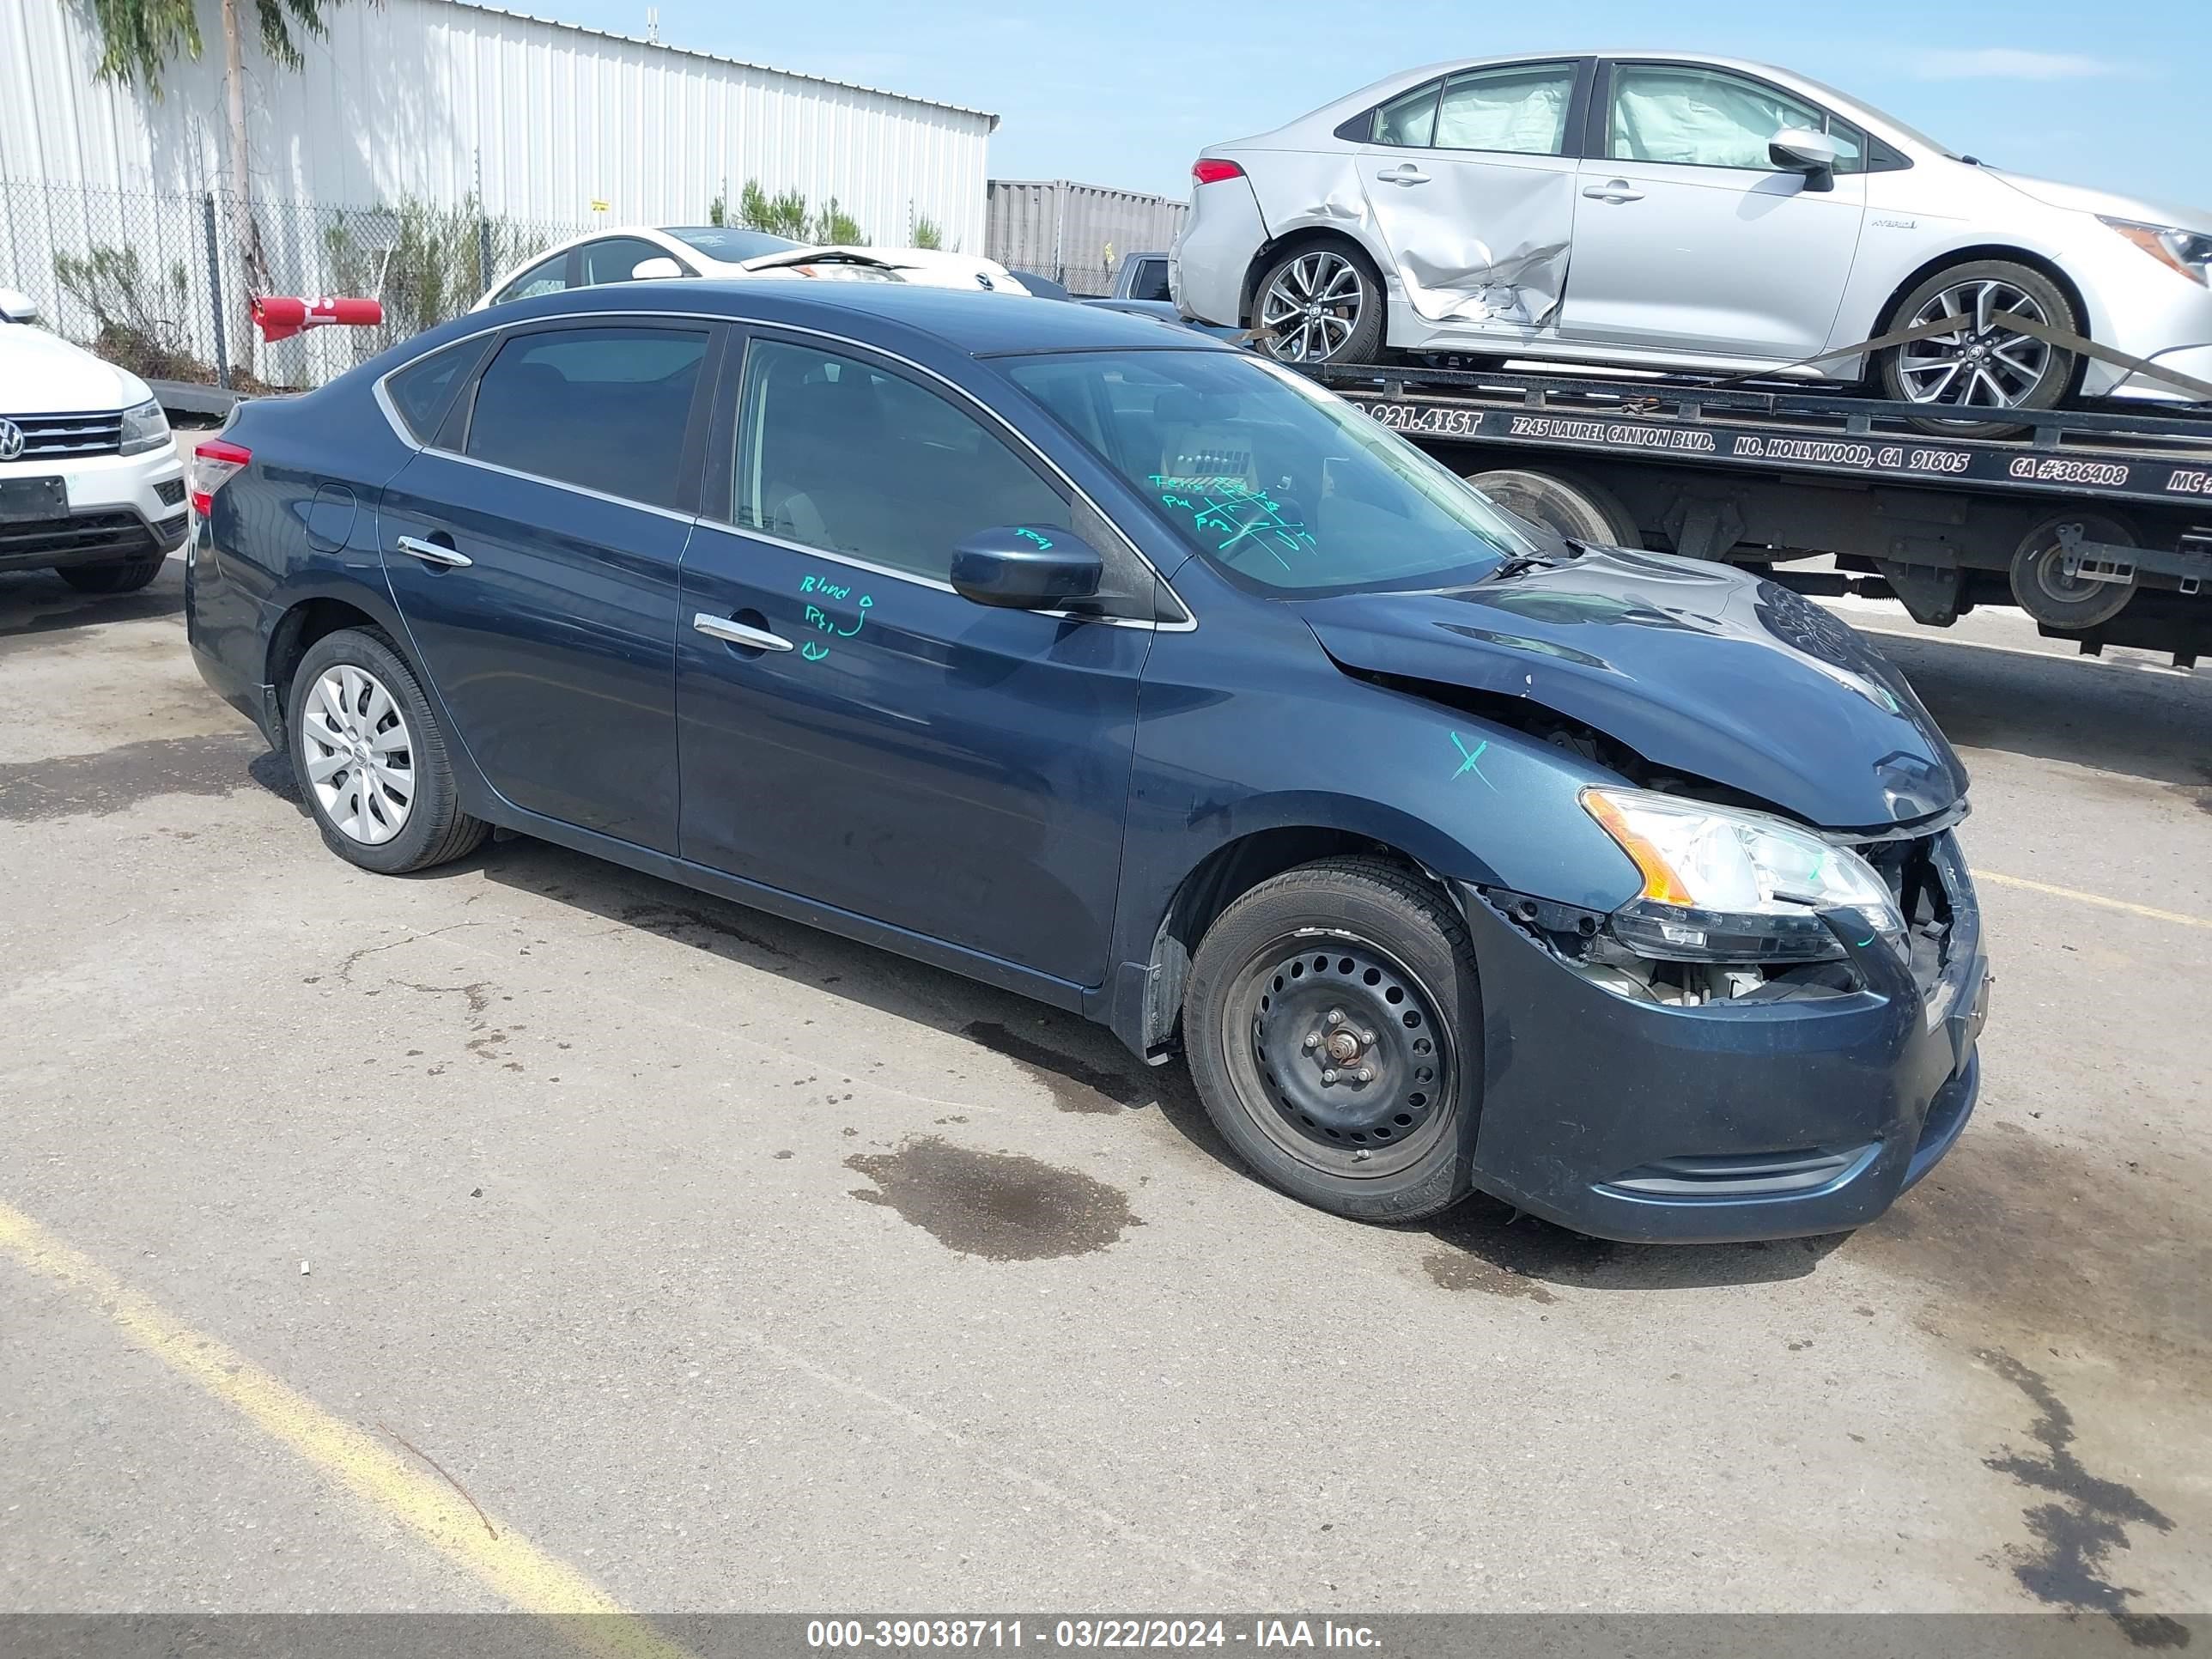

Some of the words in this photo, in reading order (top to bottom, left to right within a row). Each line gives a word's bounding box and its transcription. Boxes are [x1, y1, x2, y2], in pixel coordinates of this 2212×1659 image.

[1510, 416, 1549, 436] 7245
[1549, 419, 1605, 441] LAUREL
[1607, 425, 1669, 447] CANYON
[1669, 431, 1716, 452] BLVD.
[1734, 436, 1764, 456] NO.
[1765, 438, 1875, 468] HOLLYWOOD,
[1878, 447, 1903, 467] CA
[1908, 449, 1971, 472] 91605
[2009, 458, 2037, 478] CA
[2036, 459, 2128, 486] #386408
[2166, 471, 2204, 491] MC
